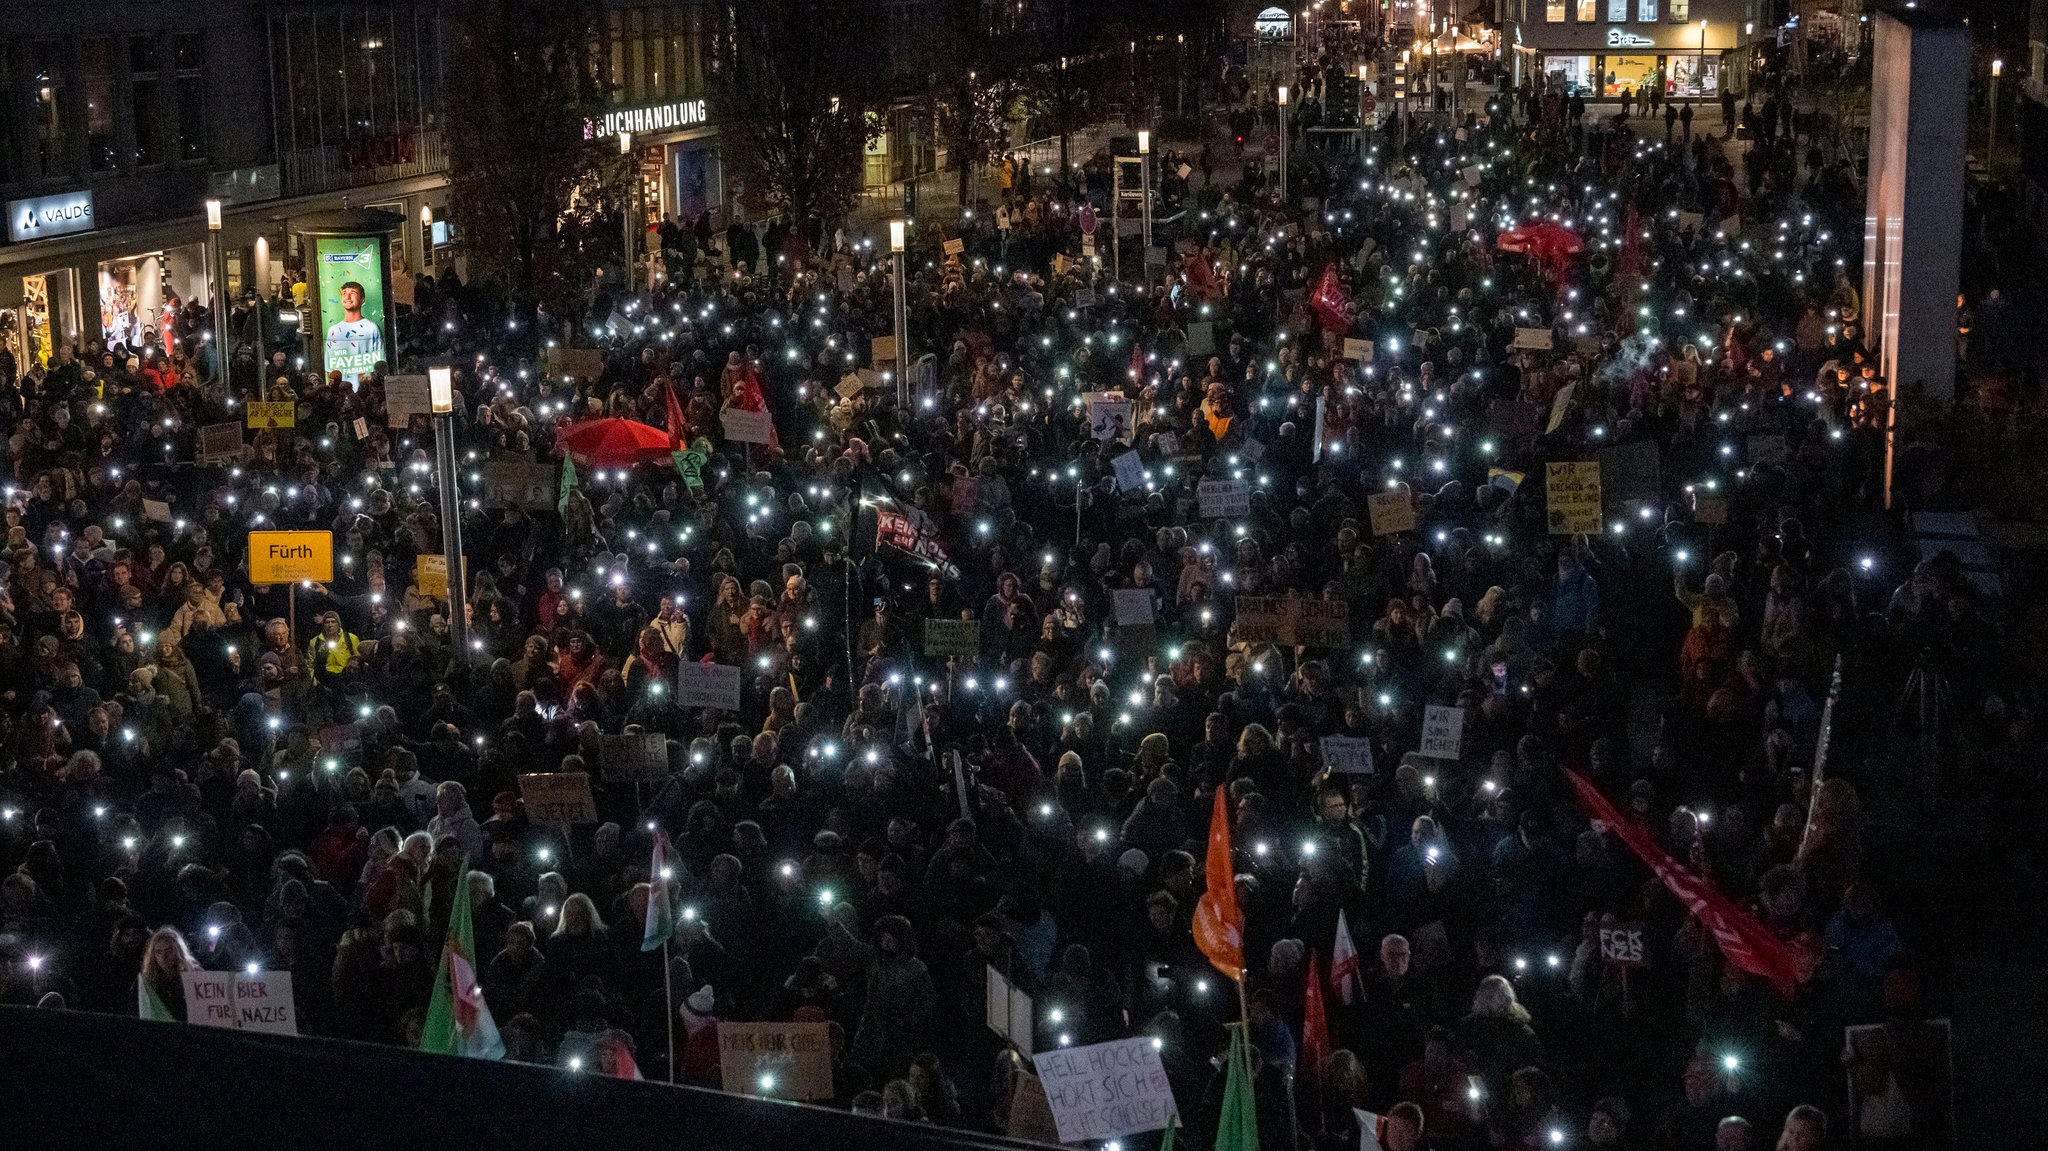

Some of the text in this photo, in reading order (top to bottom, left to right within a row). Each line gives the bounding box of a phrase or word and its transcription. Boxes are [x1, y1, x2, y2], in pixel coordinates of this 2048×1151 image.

[45, 204, 92, 223] VAUDE
[330, 350, 381, 369] FAYERN
[334, 349, 348, 357] WIR
[1548, 464, 1576, 477] WIR
[879, 515, 918, 539] KEIN
[269, 544, 313, 559] Fürth
[1428, 710, 1451, 724] WIR
[1427, 726, 1450, 738] SIND
[1599, 929, 1643, 947] FCK
[1600, 943, 1643, 961] NZS
[193, 981, 268, 1000] KEIN BIER
[242, 1006, 288, 1023] NAZIS
[1037, 1054, 1088, 1082] HEIL
[1102, 1071, 1149, 1102] SICH
[1056, 1109, 1098, 1137] ECHT
